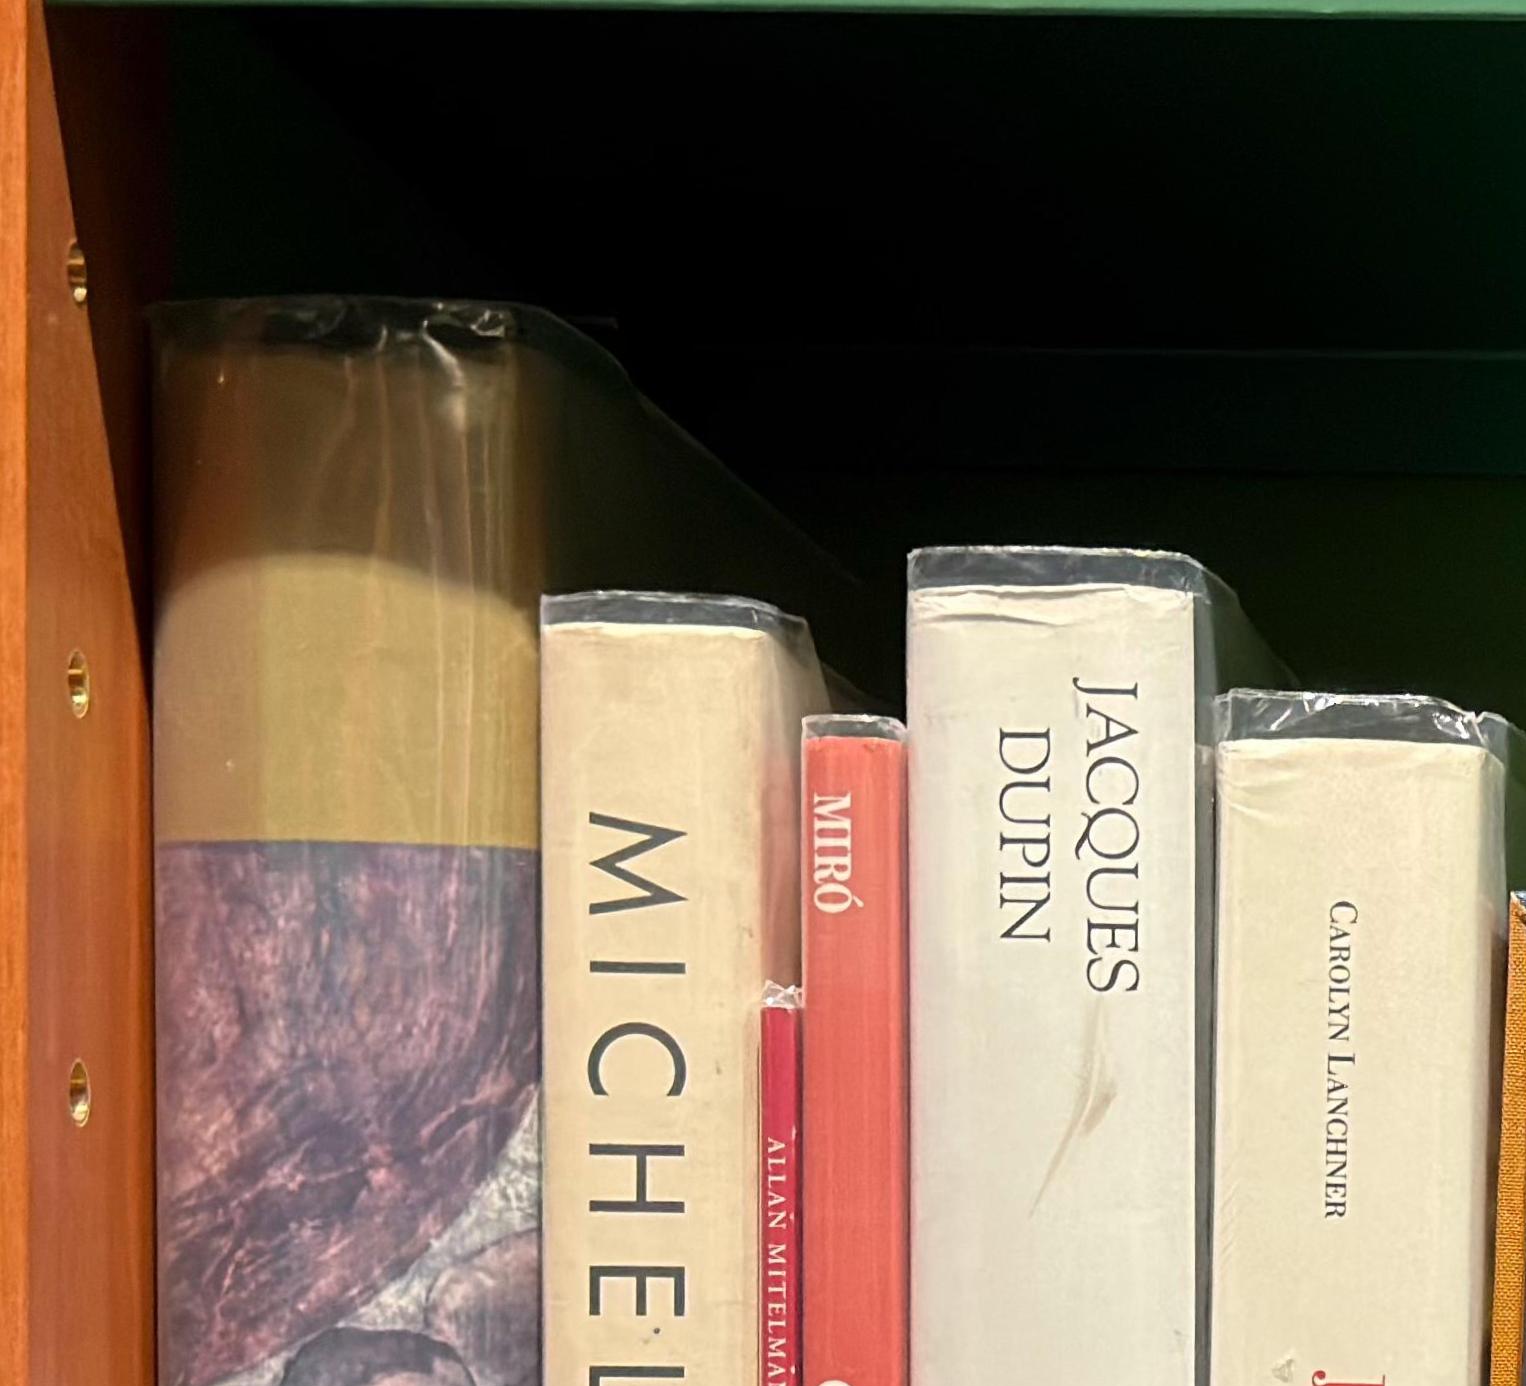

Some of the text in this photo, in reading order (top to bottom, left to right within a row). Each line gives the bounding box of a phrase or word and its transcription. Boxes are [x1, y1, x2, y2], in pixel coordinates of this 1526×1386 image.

[812, 792, 863, 914] MIRÓ
[999, 727, 1051, 943] DUPIN
[1072, 677, 1139, 993] JACQUES
[767, 1137, 787, 1229] ALLAN
